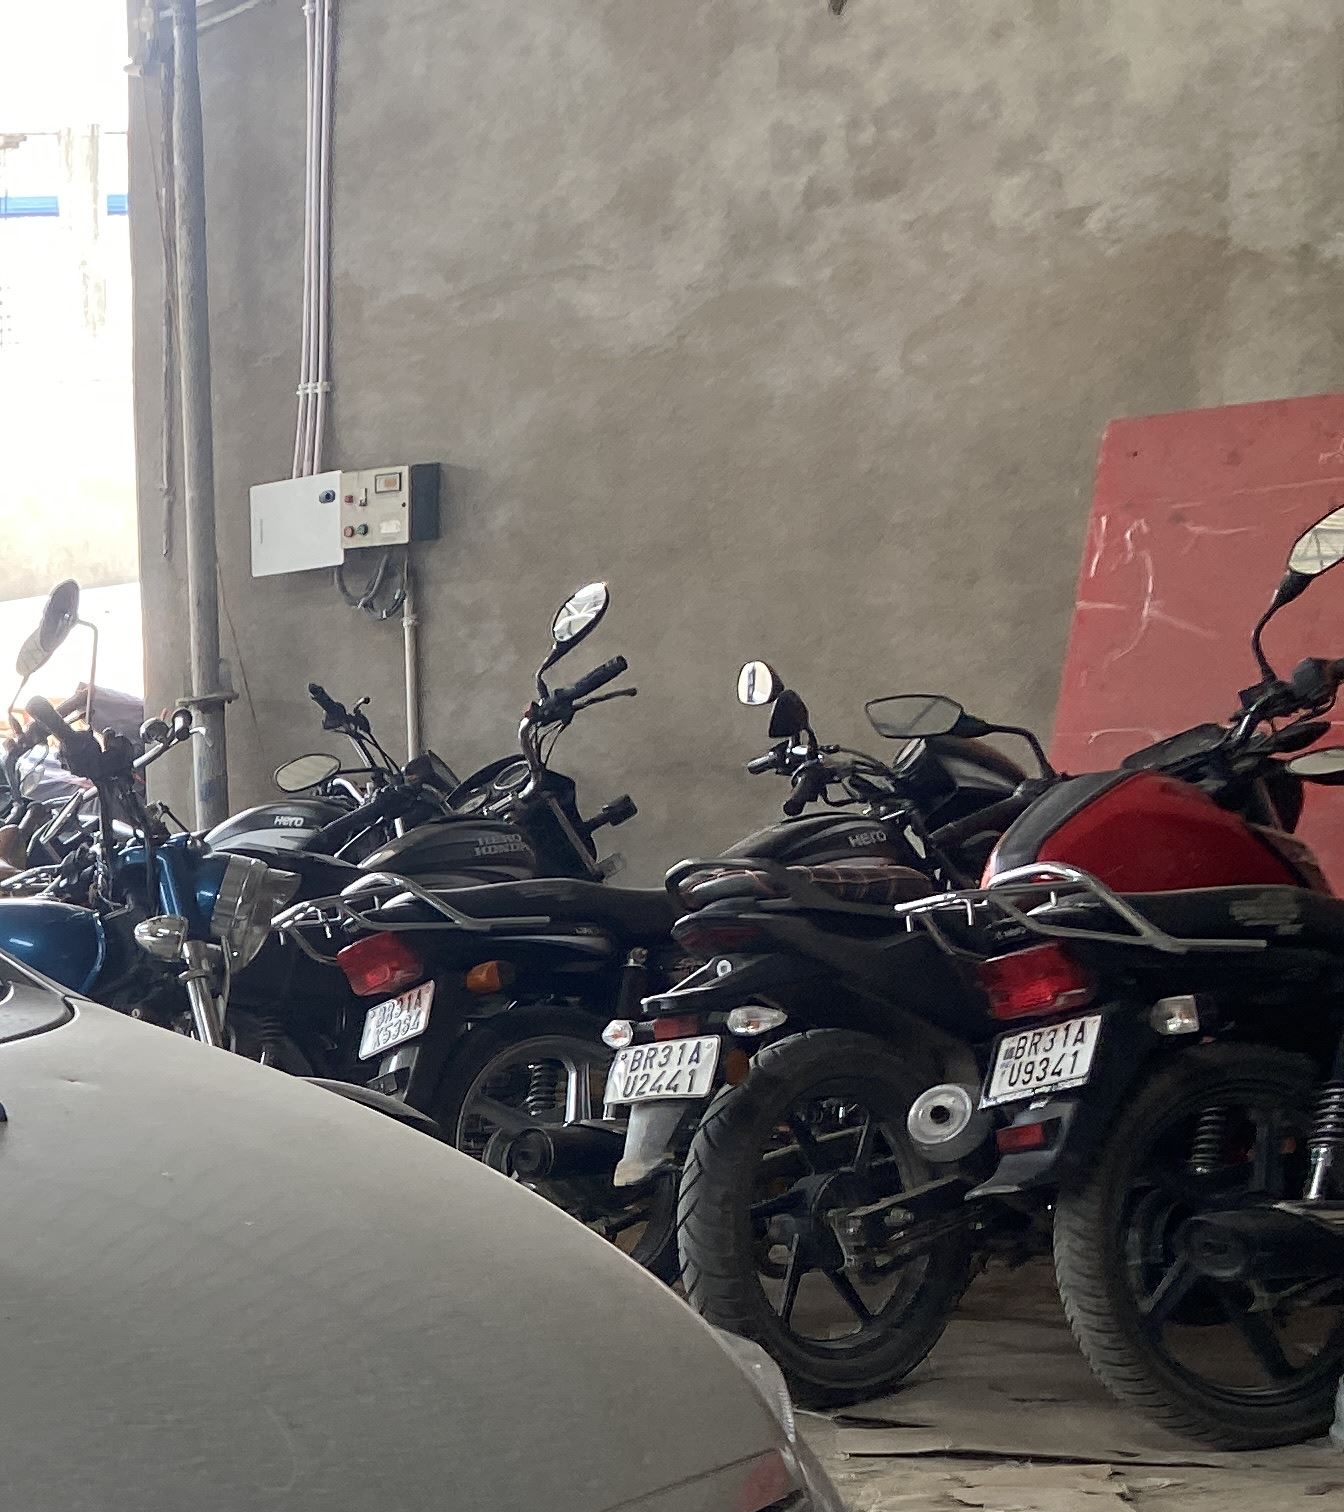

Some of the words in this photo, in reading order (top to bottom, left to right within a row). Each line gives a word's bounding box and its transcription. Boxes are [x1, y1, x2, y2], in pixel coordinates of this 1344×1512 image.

[629, 1041, 701, 1073] BR31A
[1014, 1020, 1086, 1060] BR31A
[623, 1068, 696, 1098] U2441
[1008, 1049, 1079, 1087] U9341
